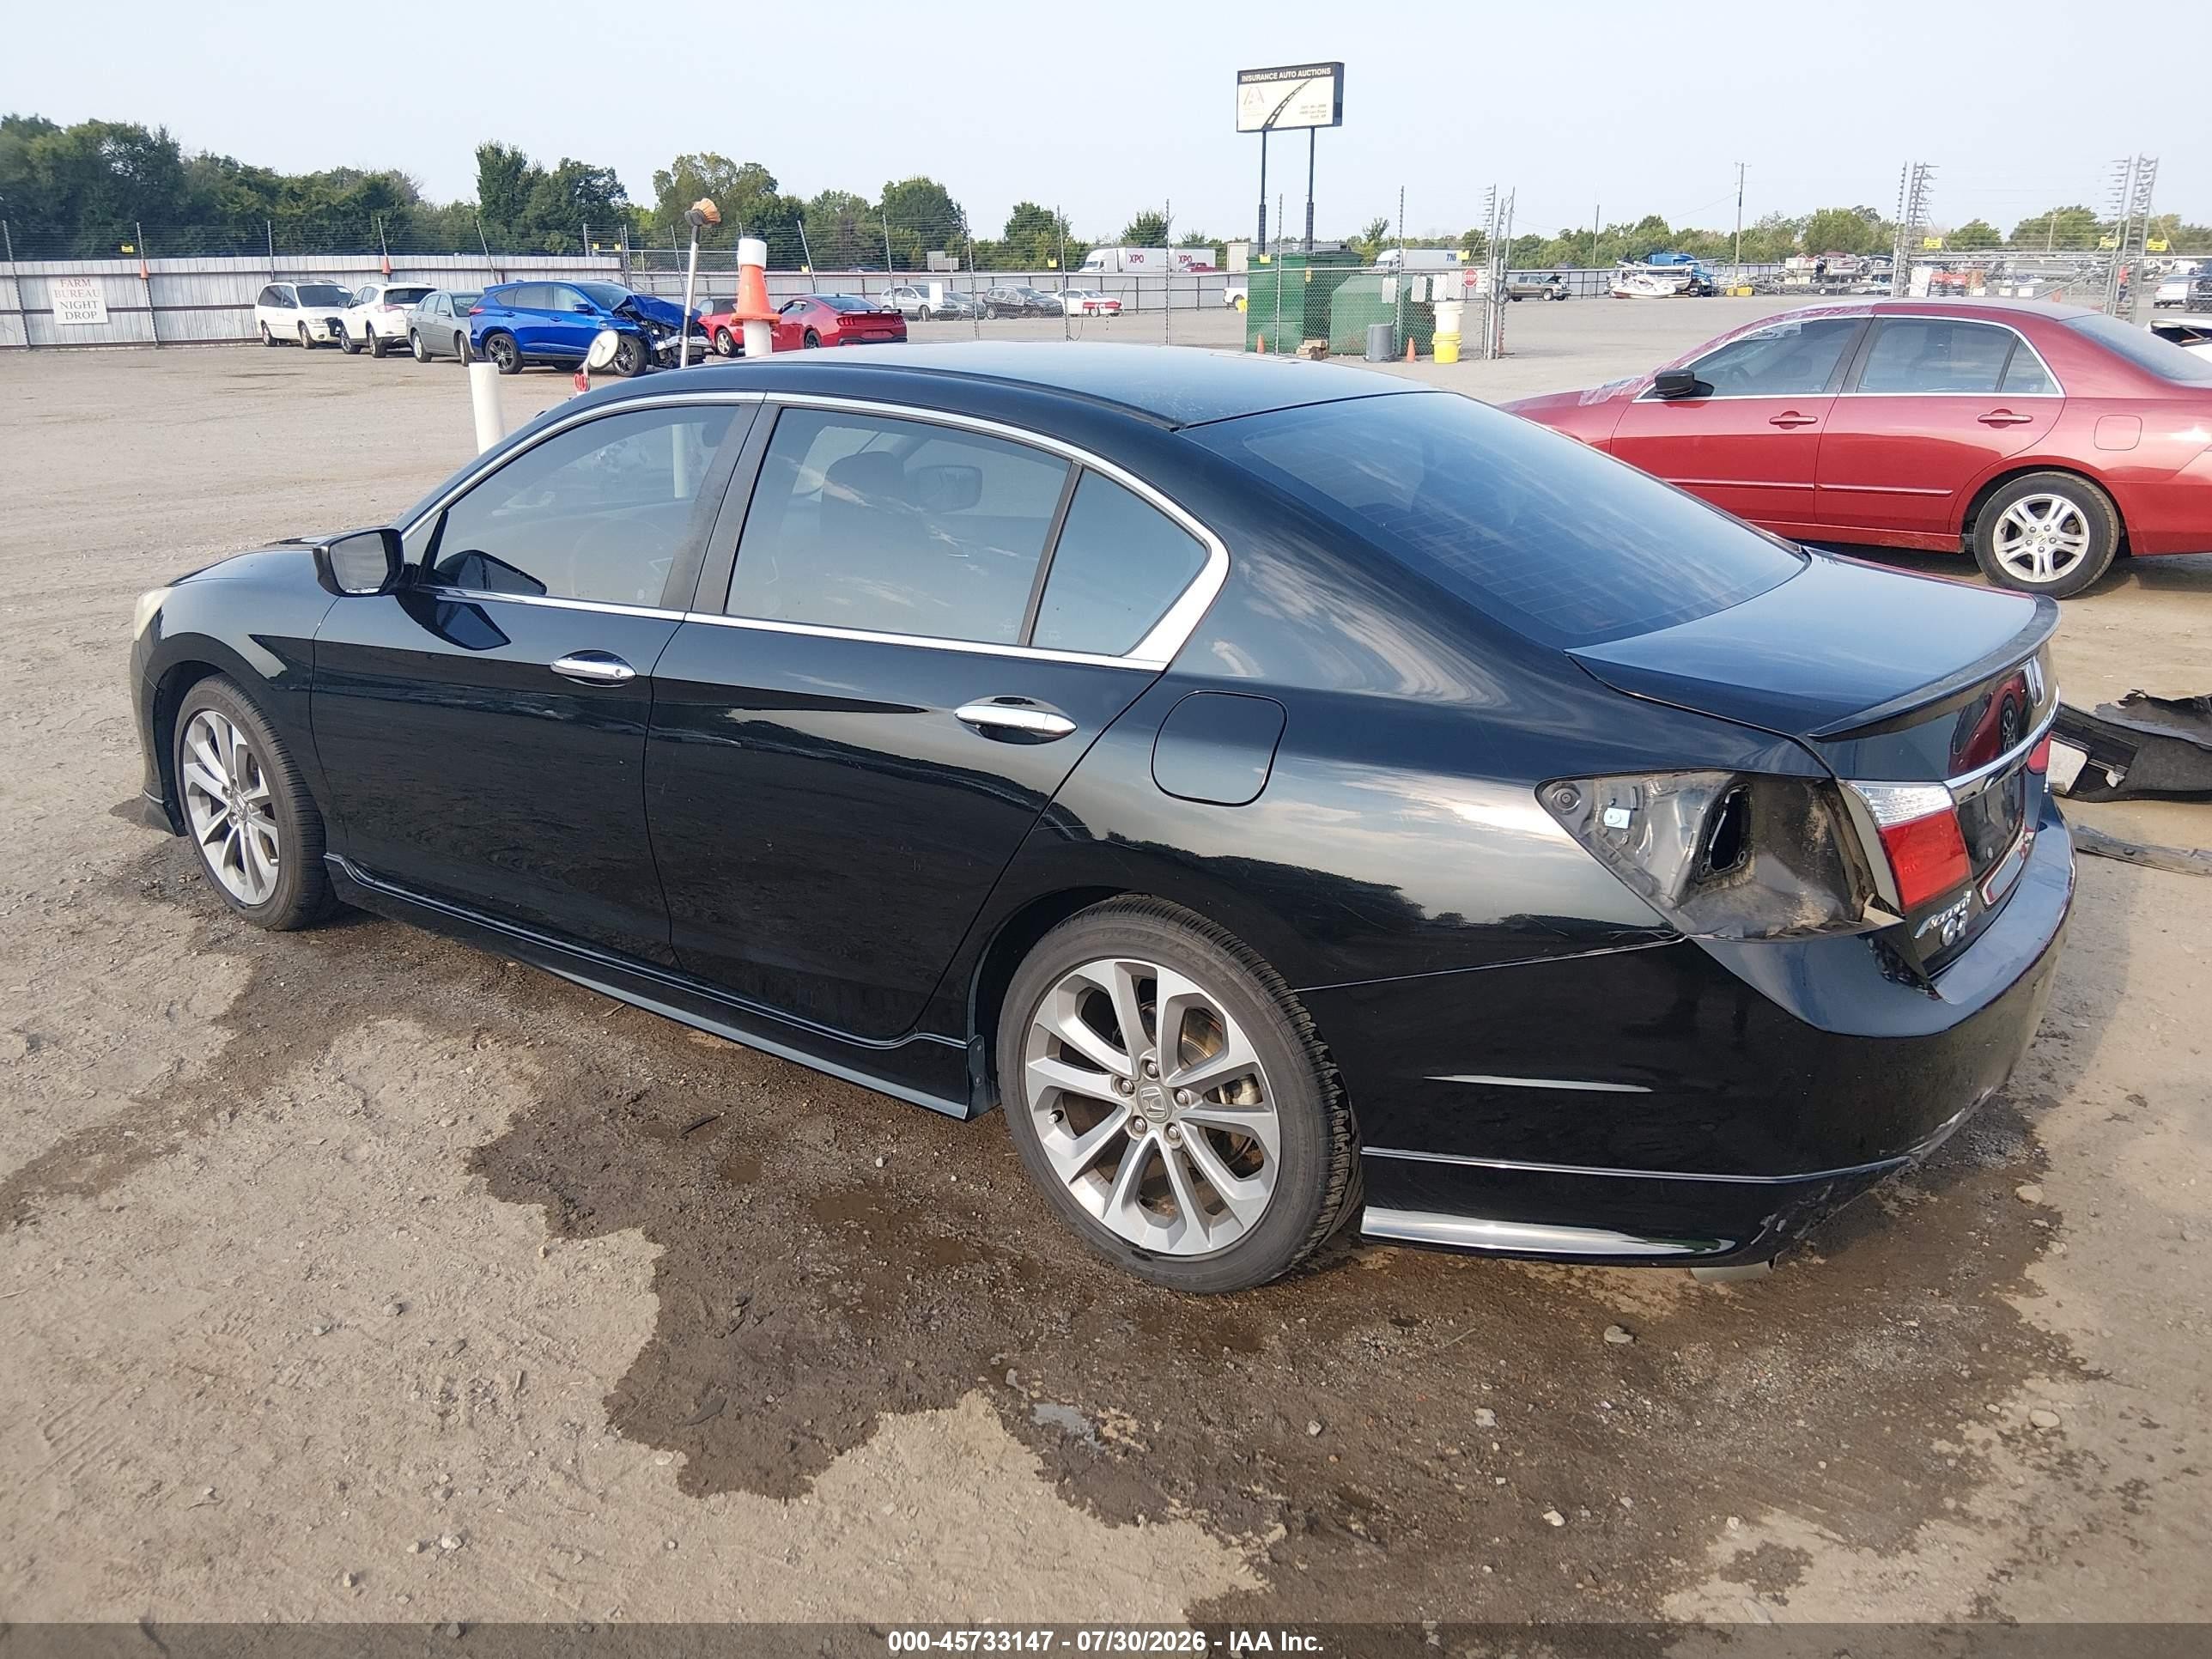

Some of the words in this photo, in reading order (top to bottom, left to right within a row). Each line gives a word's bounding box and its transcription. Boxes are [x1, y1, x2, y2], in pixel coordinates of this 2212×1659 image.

[1241, 72, 1278, 82] INSURANCE
[1279, 70, 1297, 79] AUTO
[1297, 67, 1331, 77] AUCTIONS
[1129, 253, 1145, 264] XPO
[1178, 254, 1192, 264] XPO
[60, 278, 91, 288] FARM
[54, 289, 100, 298] BUREAU
[60, 301, 99, 310] NIGHT
[65, 311, 97, 320] DROP
